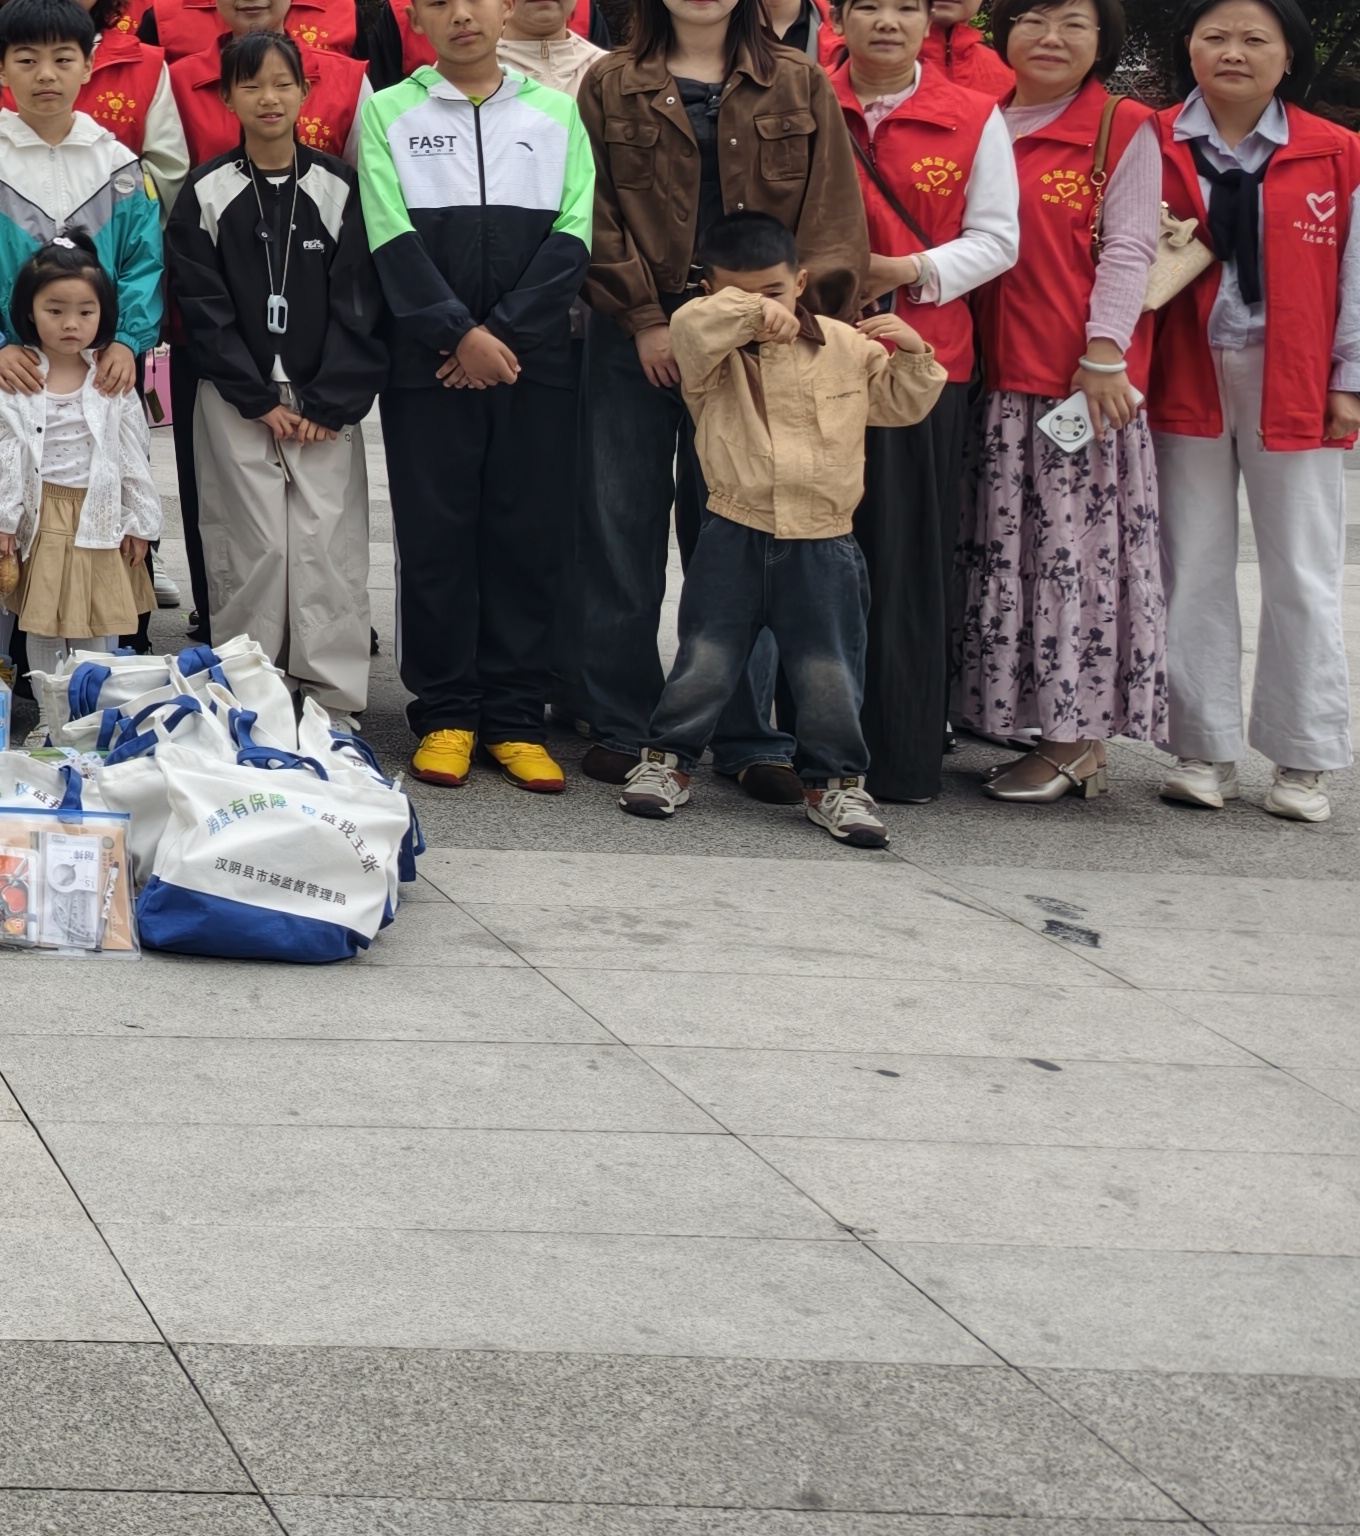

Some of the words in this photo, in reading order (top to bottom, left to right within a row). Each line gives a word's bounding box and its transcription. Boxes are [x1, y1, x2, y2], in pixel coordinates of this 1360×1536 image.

[409, 135, 457, 150] FAST
[205, 792, 288, 837] 消费有保障
[300, 803, 381, 874] 权益我主张
[214, 855, 347, 906] 汉阴县市场监督管理局
